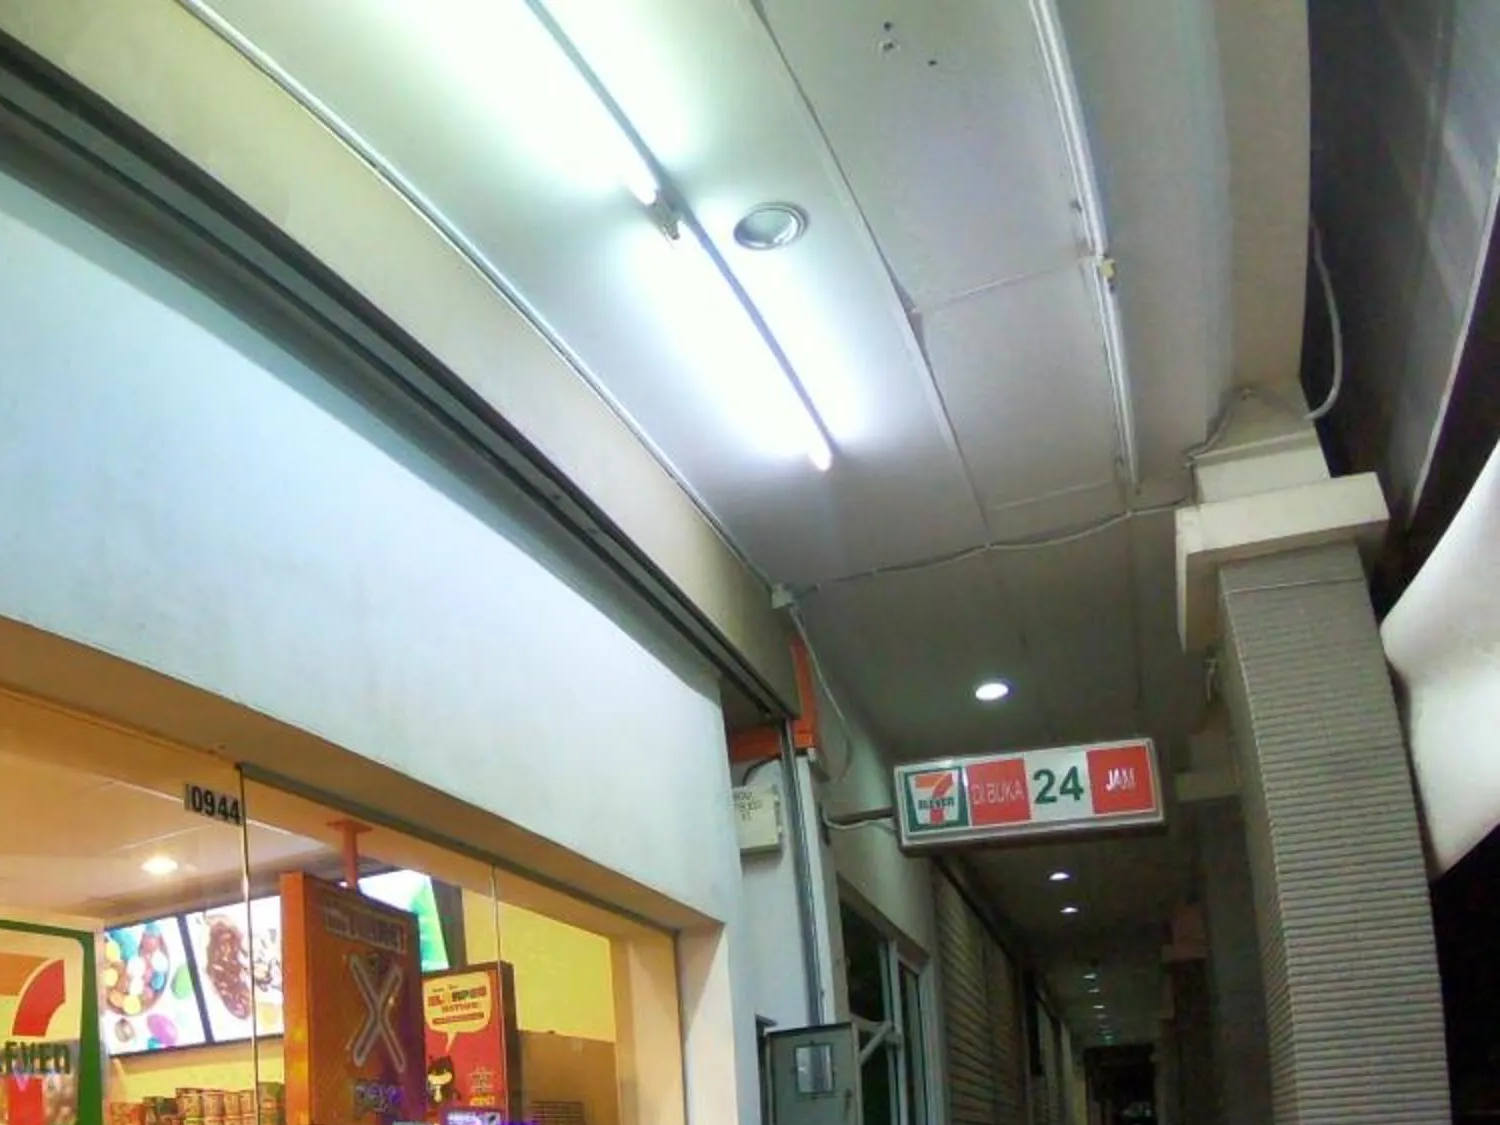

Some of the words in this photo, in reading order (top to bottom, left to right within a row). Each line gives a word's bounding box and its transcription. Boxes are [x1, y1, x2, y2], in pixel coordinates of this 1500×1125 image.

[191, 785, 239, 825] 0944
[1032, 765, 1085, 805] 24
[1105, 767, 1138, 792] JAM
